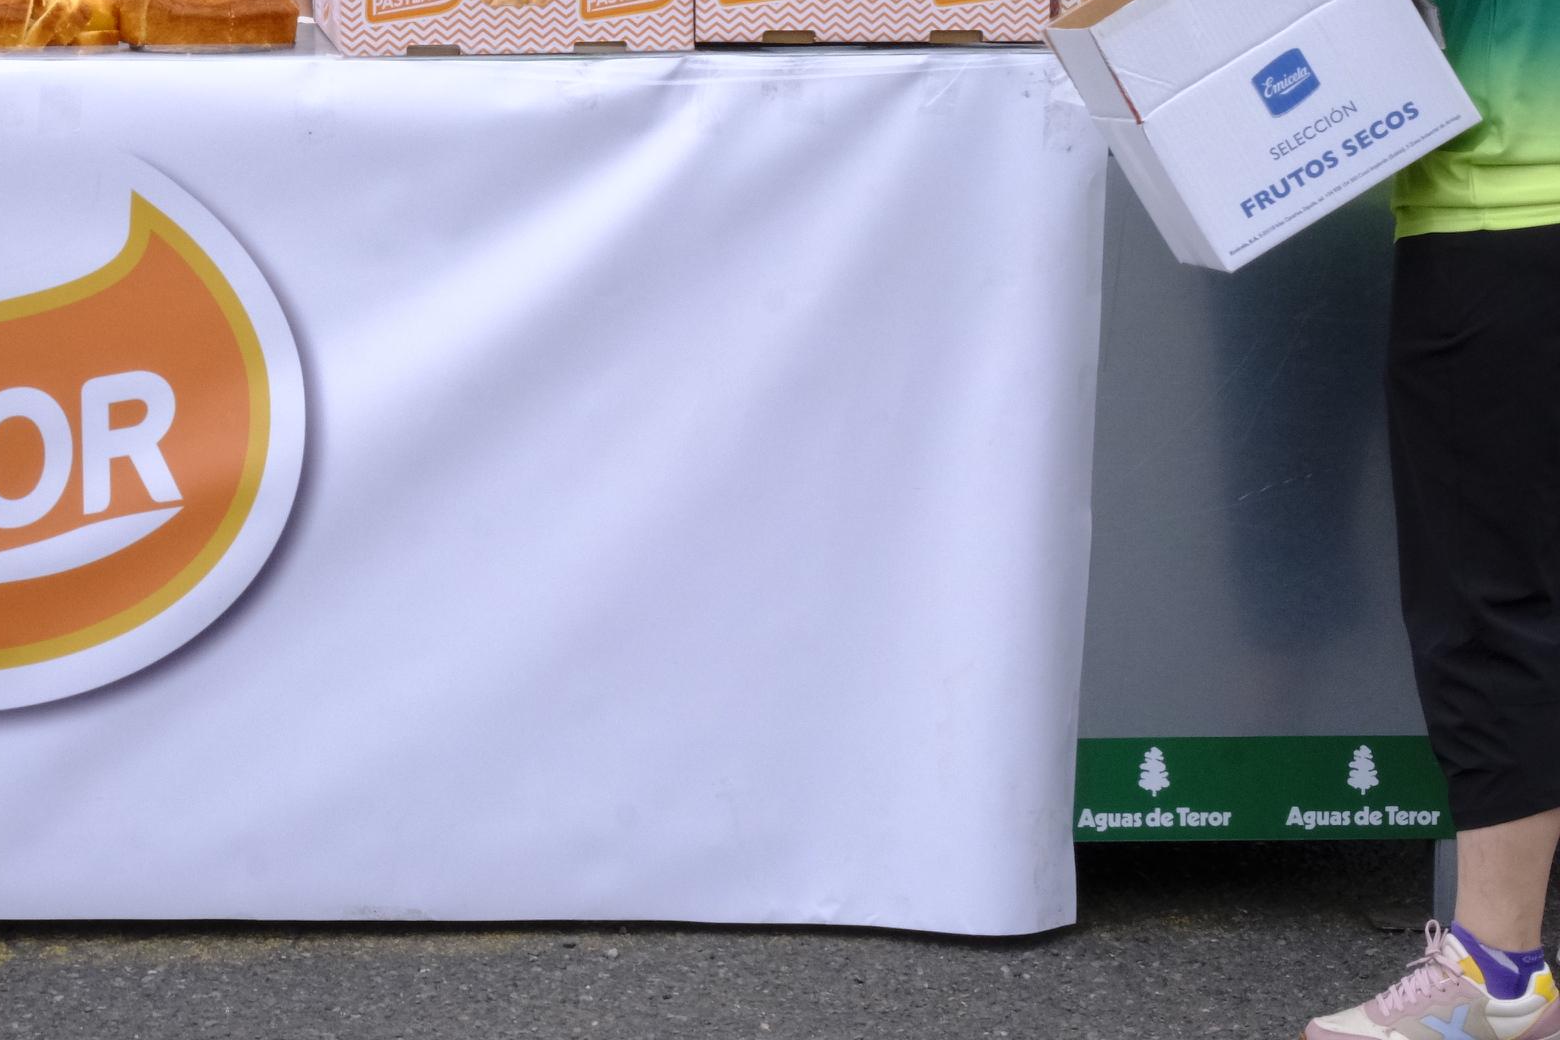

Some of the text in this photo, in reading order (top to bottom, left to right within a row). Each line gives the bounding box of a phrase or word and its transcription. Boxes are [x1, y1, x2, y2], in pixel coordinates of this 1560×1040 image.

[1261, 66, 1311, 99] Emicela
[1269, 99, 1358, 161] SELECCIÓN
[1239, 150, 1339, 219] FRUTOS
[1341, 100, 1420, 158] SECOS
[1078, 807, 1232, 833] Aguas de Teror
[1285, 805, 1441, 831] Aguas de Teror
